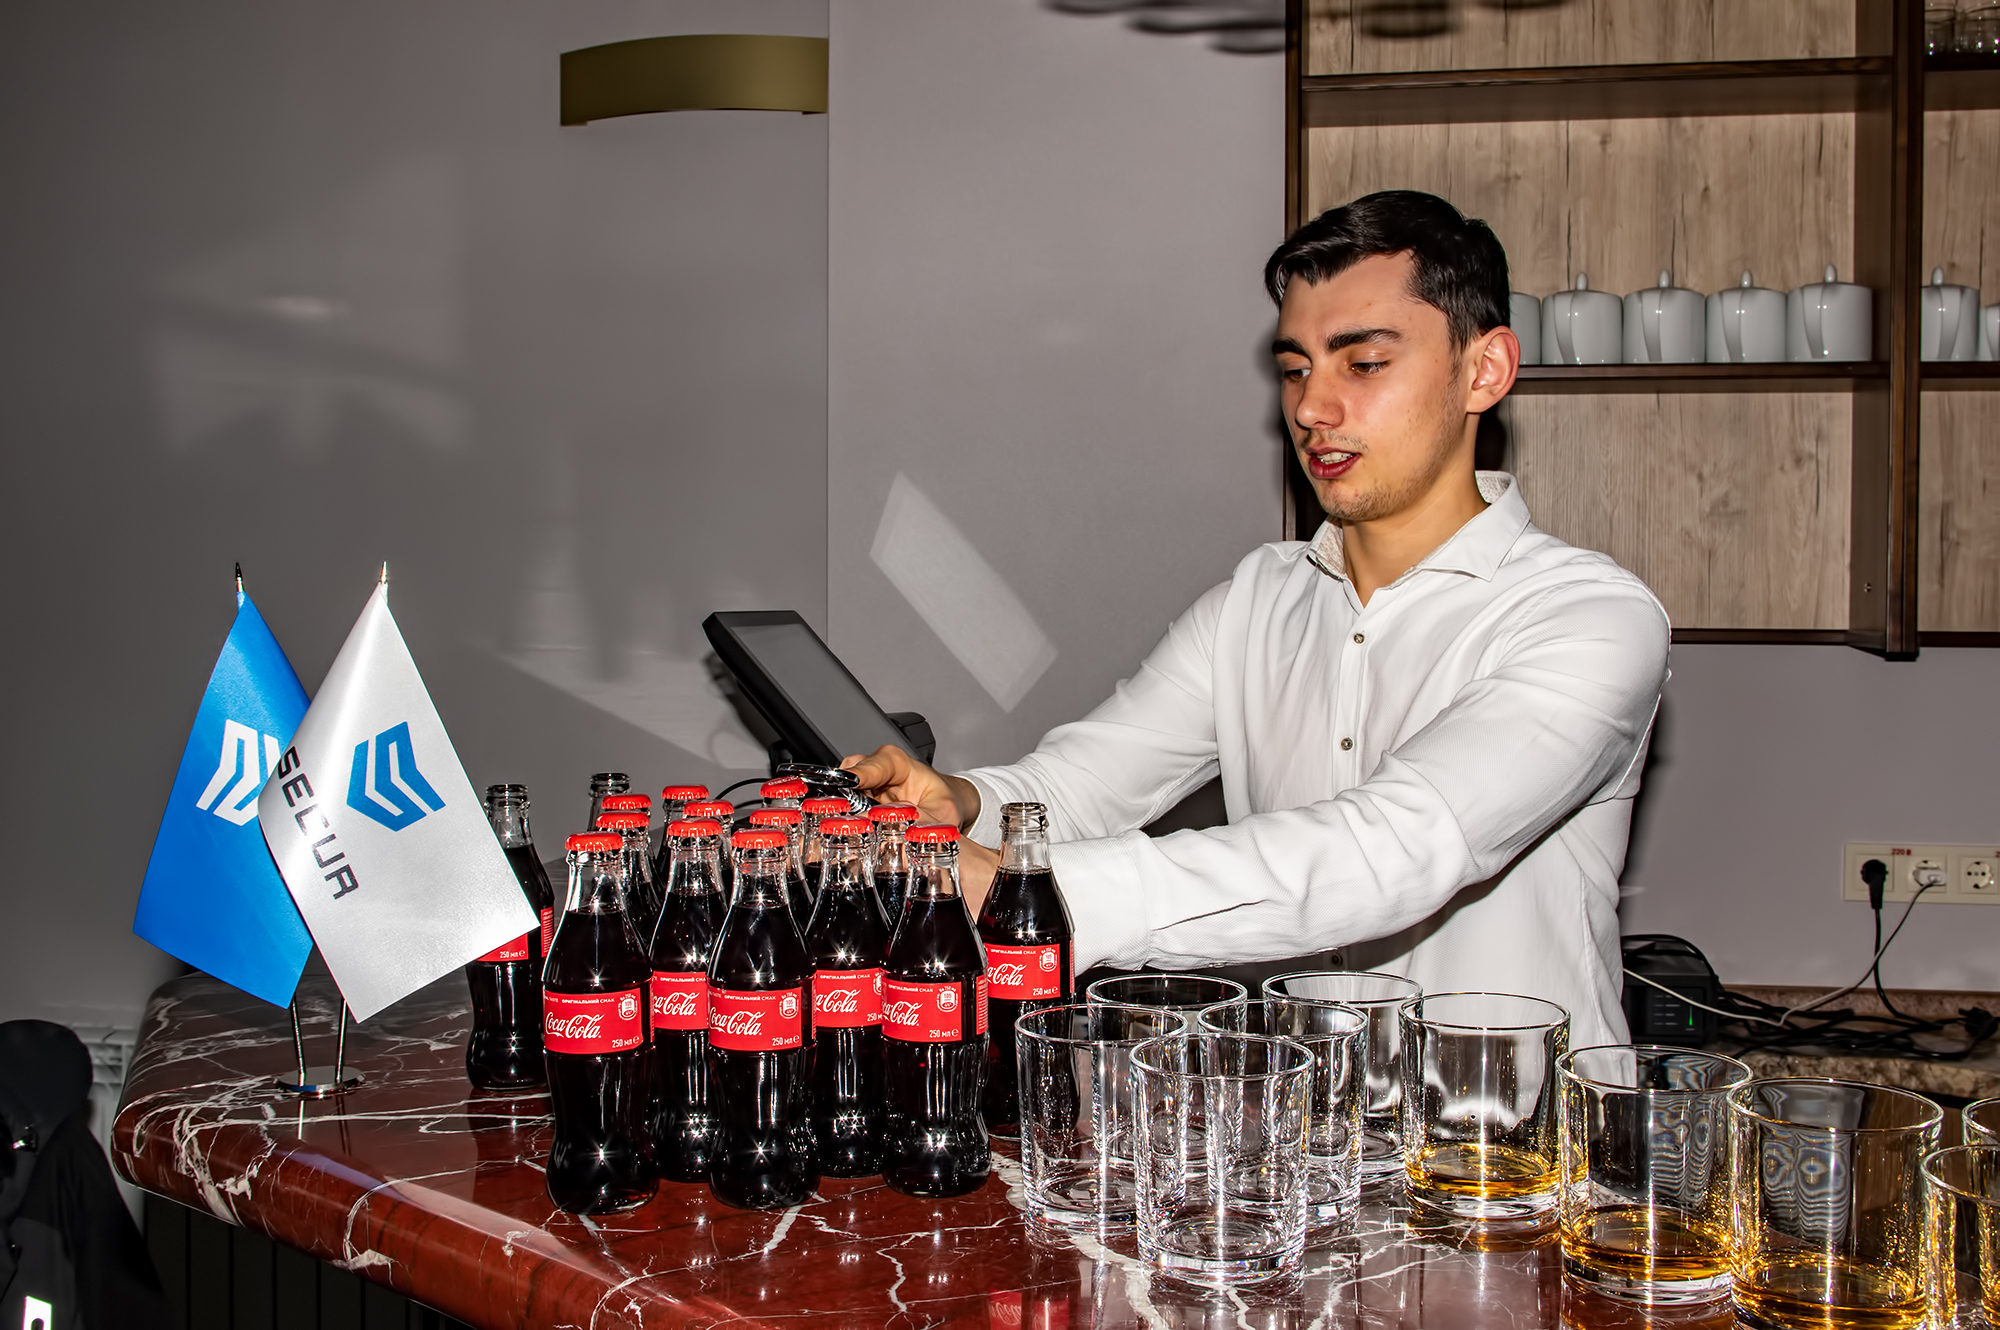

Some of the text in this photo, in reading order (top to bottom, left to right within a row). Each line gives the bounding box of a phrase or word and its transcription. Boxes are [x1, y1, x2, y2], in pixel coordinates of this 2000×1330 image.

[277, 745, 360, 900] SECUR
[1033, 988, 1043, 996] 250
[867, 1013, 877, 1022] 250
[545, 1011, 605, 1039] Coca-Cola
[929, 1029, 940, 1038] 250
[612, 1038, 623, 1048] 250
[772, 1037, 783, 1046] 250
